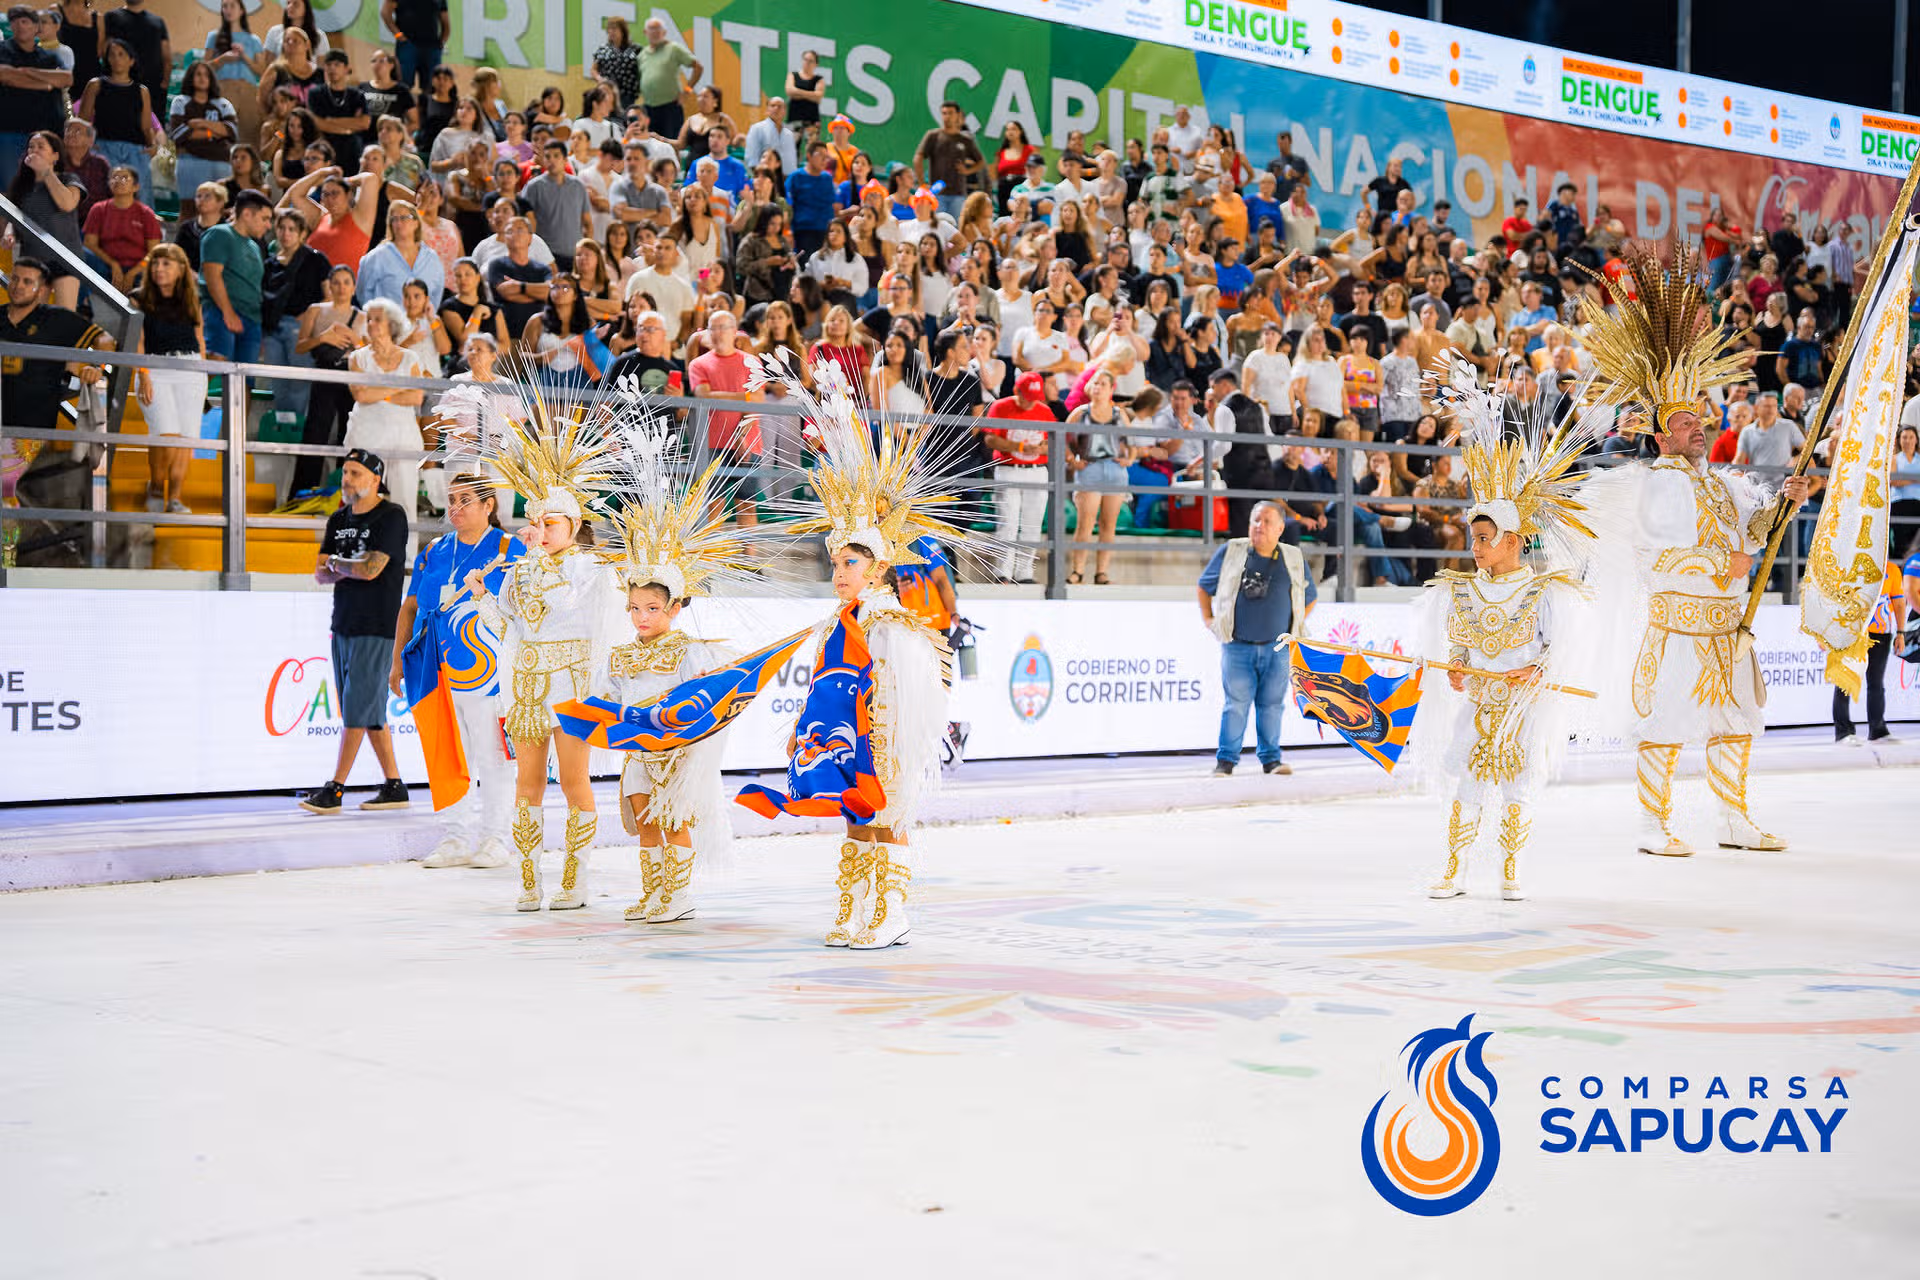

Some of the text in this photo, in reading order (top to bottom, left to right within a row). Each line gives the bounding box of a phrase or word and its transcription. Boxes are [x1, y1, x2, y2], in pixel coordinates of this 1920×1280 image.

[1184, 0, 1309, 50] DENGUE
[1562, 76, 1660, 118] DENGUE
[1861, 130, 1918, 162] DENG
[1066, 659, 1176, 676] GOBIERNO DE
[1758, 651, 1824, 665] OBIERNO DE
[1762, 667, 1825, 687] ORRIENT
[1066, 680, 1201, 703] CORRIENTES
